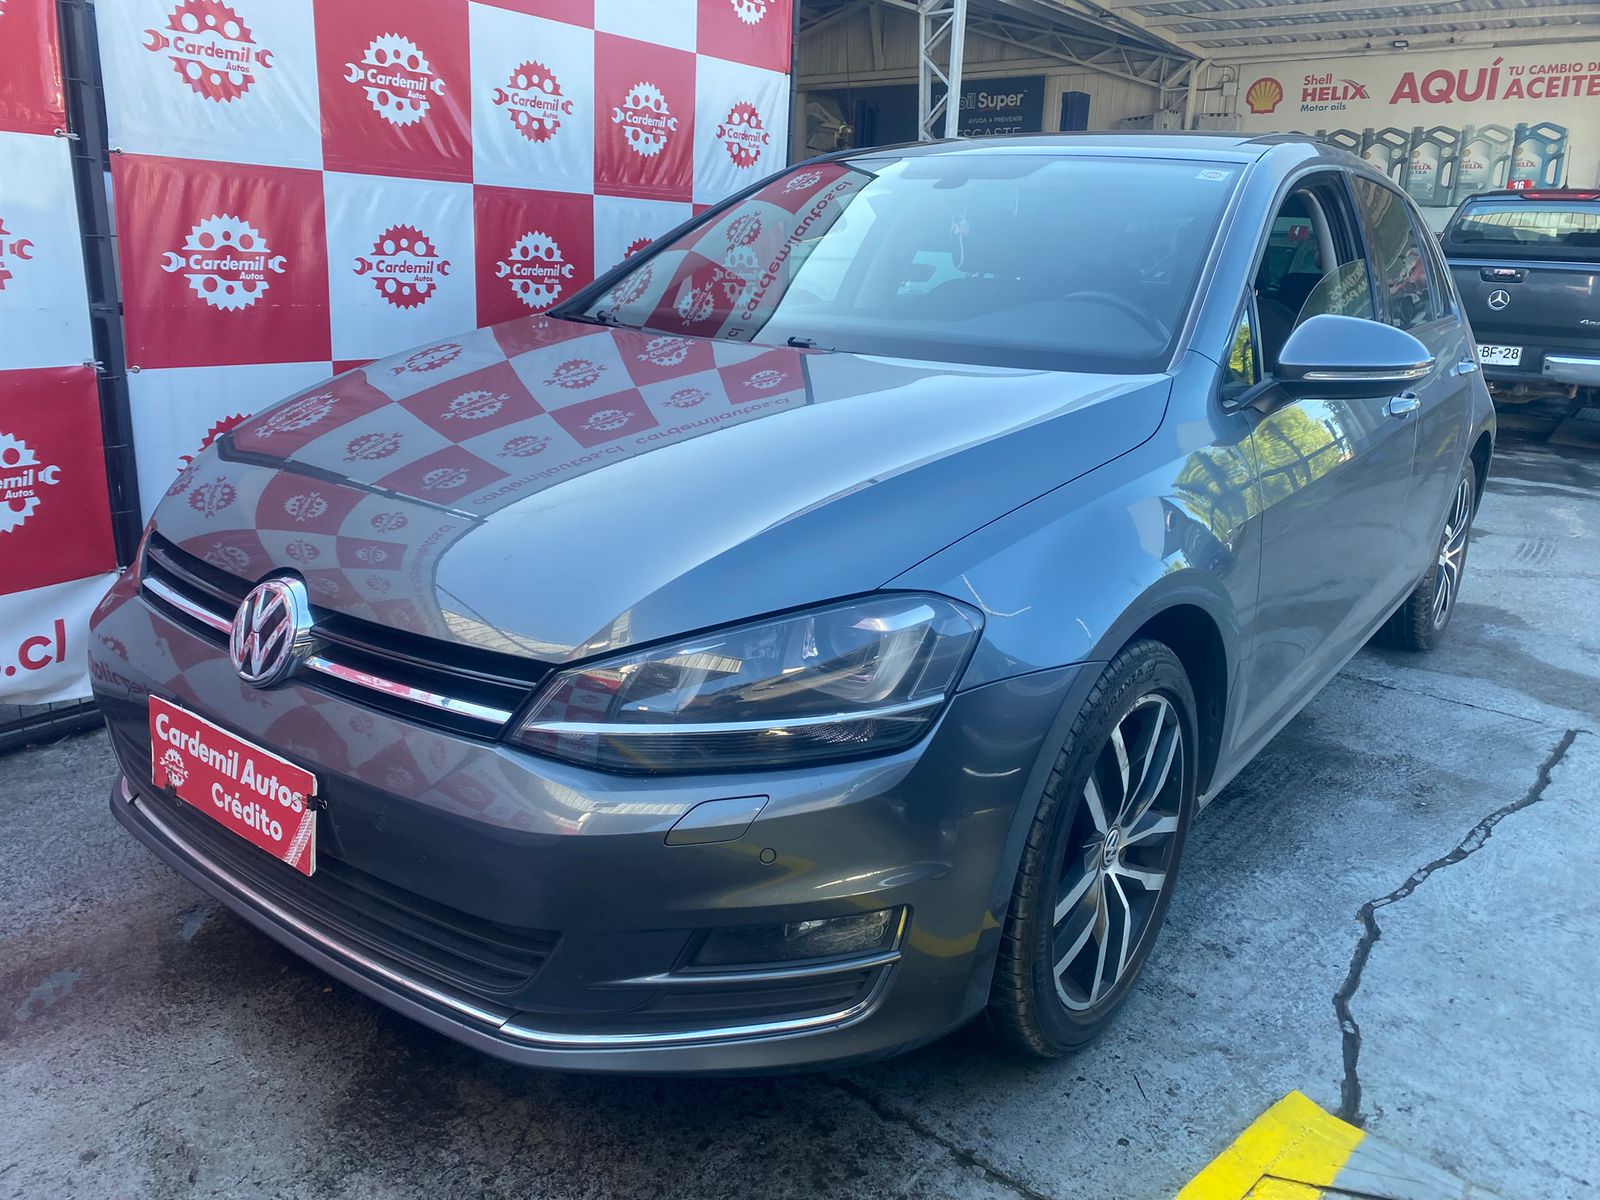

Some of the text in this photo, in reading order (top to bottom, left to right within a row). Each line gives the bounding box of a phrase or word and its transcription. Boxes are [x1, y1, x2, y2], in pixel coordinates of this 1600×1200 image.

[173, 36, 251, 63] Cardemil
[225, 62, 250, 73] Autos
[1508, 65, 1525, 76] TU
[1529, 62, 1583, 75] CAMBIO
[367, 68, 428, 91] Cardemil
[1303, 73, 1333, 86] Shell
[1388, 56, 1504, 104] AQUÍ
[1301, 80, 1370, 103] HELIX
[1502, 74, 1600, 100] ACEITE
[407, 90, 427, 100] Autos
[511, 92, 560, 111] Cardemil
[977, 92, 1024, 111] Super
[1300, 102, 1347, 113] Motor oils
[543, 111, 558, 119] Autos
[626, 111, 666, 128] Cardemil
[994, 115, 1023, 123] PREVENIR
[727, 128, 761, 142] Cardemil
[189, 254, 265, 271] Cardemil
[376, 259, 434, 274] Cardemil
[239, 272, 264, 280] Autos
[512, 263, 560, 277] Cardemil
[414, 274, 433, 282] Autos
[4, 489, 34, 500] Autos
[155, 713, 303, 813] Cardemil Autos
[211, 782, 283, 842] Crédito
